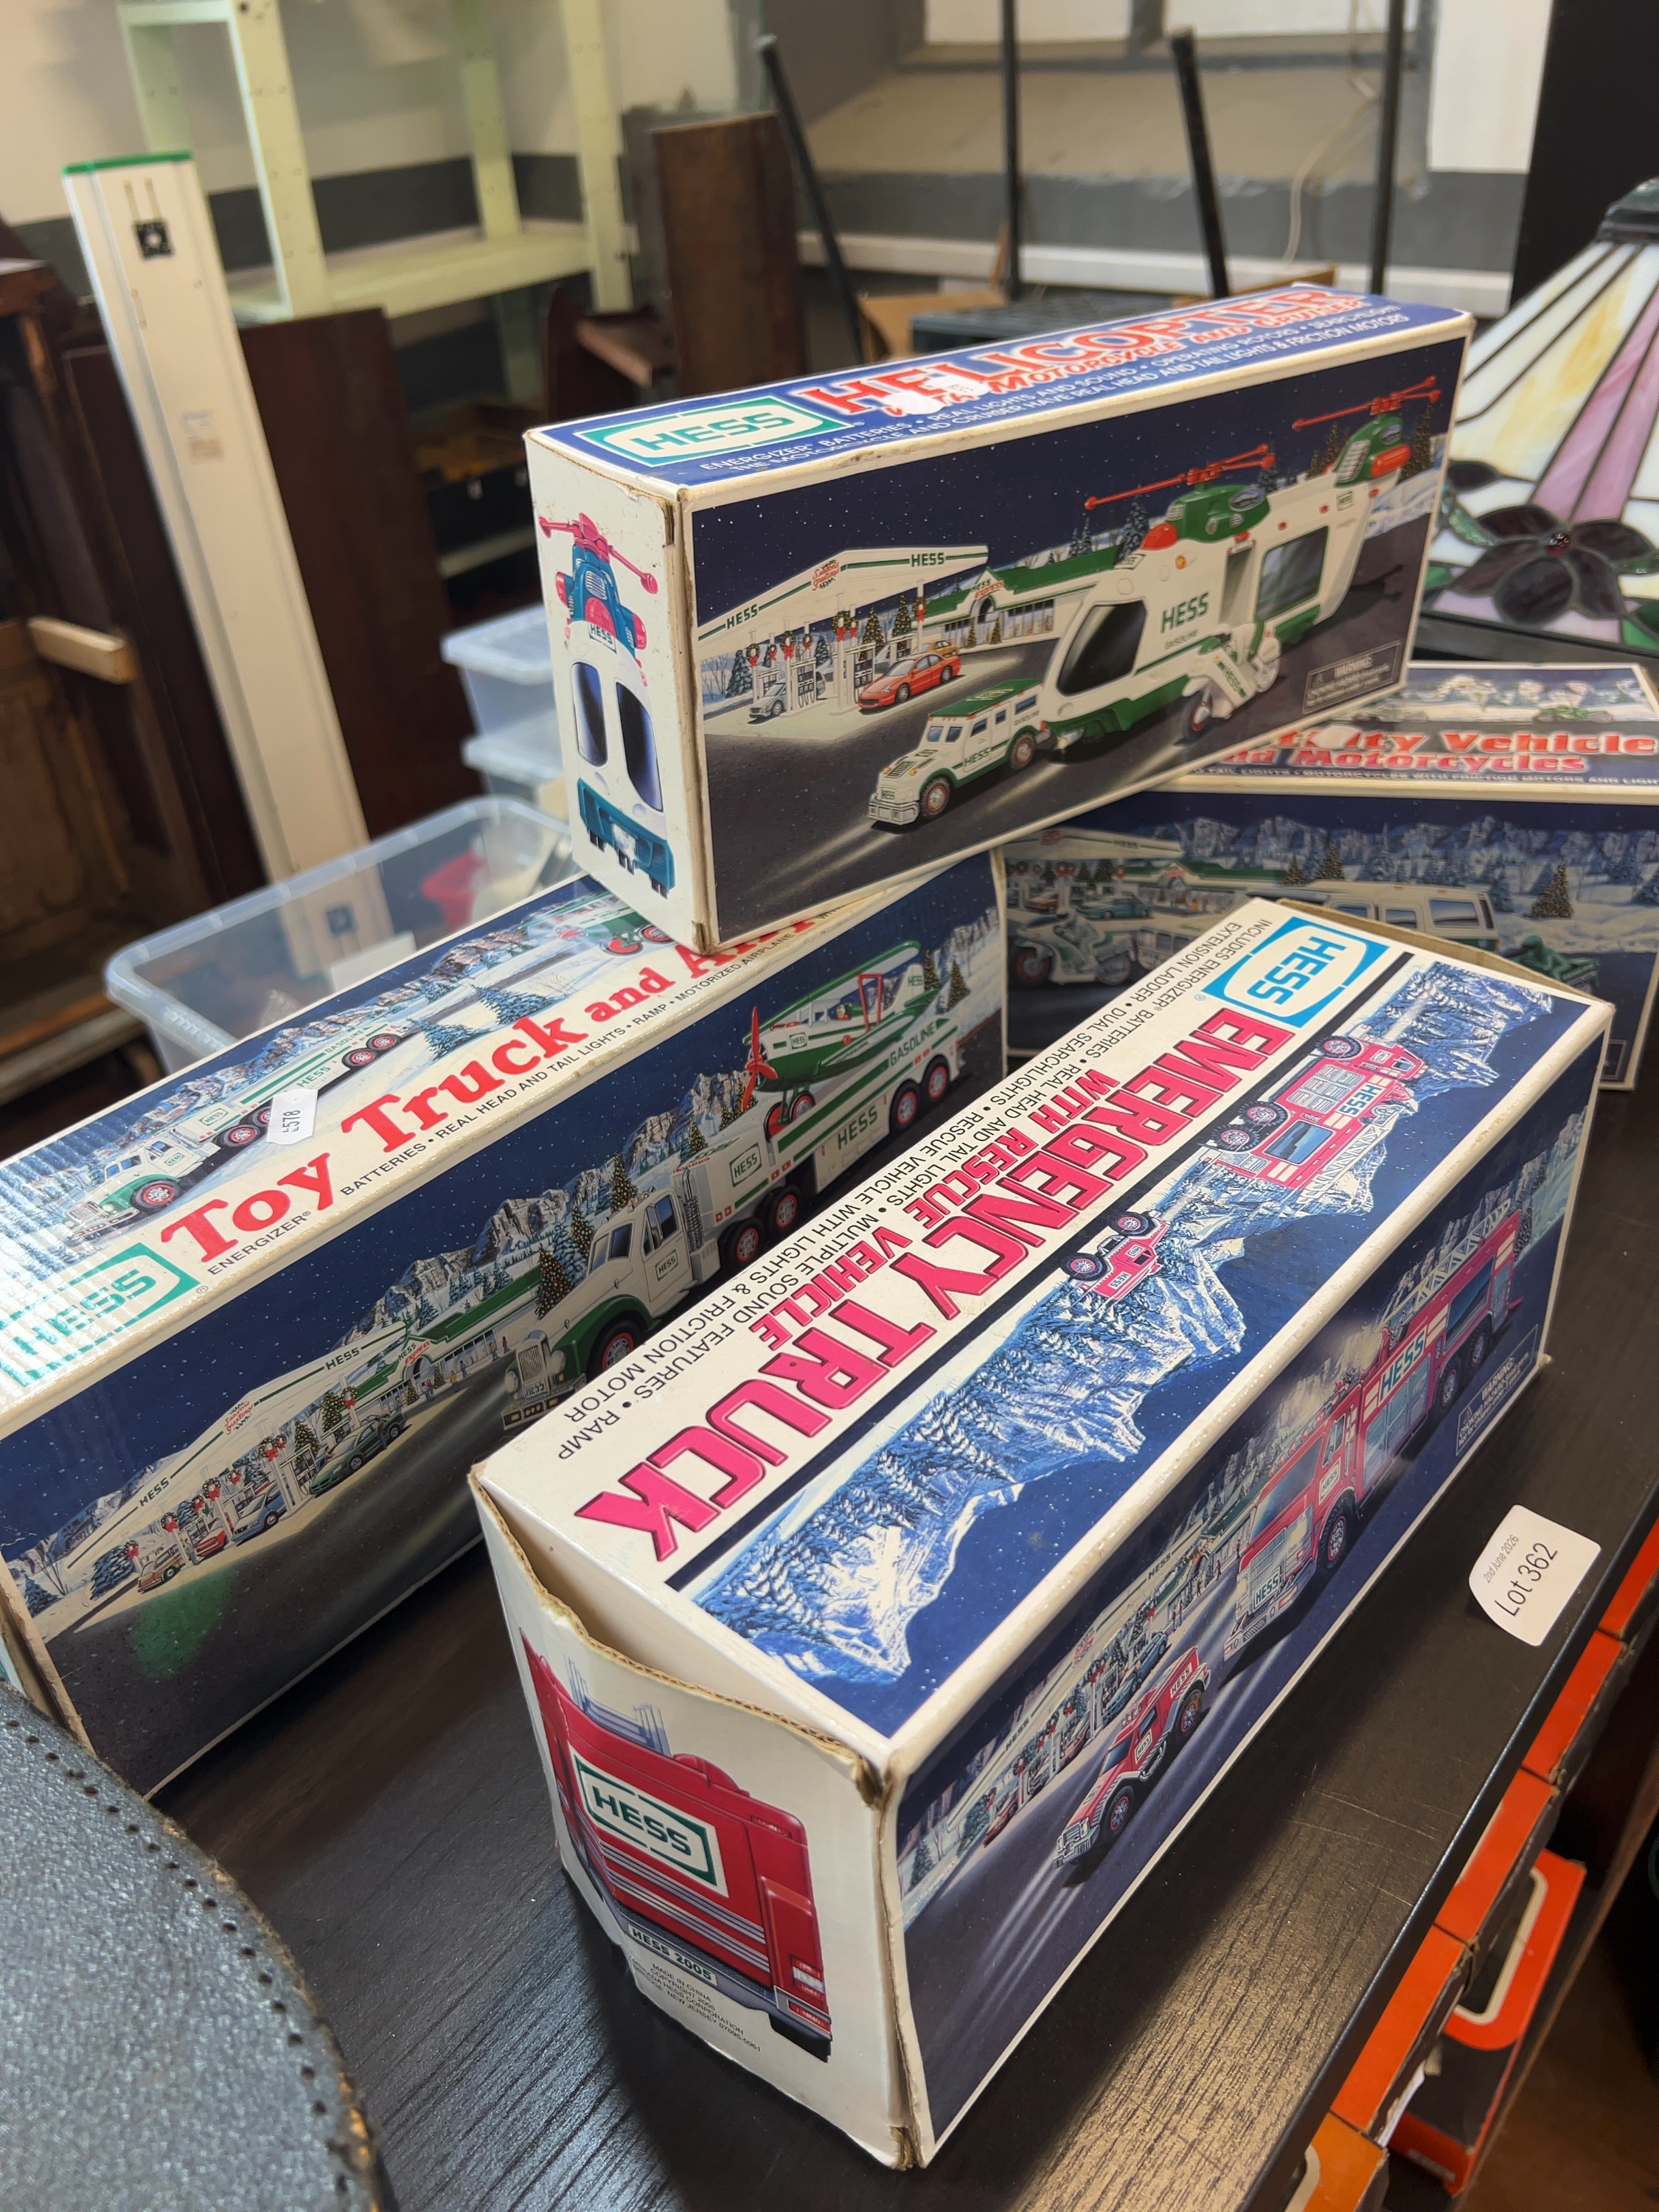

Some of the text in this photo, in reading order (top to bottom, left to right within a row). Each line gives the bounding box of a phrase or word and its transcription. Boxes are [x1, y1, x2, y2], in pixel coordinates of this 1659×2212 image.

[799, 291, 1360, 414] HELICOPTER
[911, 421, 952, 435] AND
[952, 405, 1023, 425] CRUISER
[1023, 392, 1074, 408] HAVE
[1073, 383, 1116, 398] REAL
[1116, 371, 1159, 388] HEAD
[1161, 364, 1196, 378] AND
[1195, 355, 1223, 369] TAIL
[1224, 344, 1276, 361] LIGHTS
[1285, 325, 1351, 347] FRICTION
[1349, 313, 1410, 334] MOTORS
[819, 422, 913, 446] BATTERIES
[928, 410, 970, 422] REAL
[973, 393, 1036, 414] LIGHTS
[1036, 383, 1076, 397] AND
[1074, 368, 1138, 388] SOUND
[1151, 342, 1240, 367] OPERATING
[628, 412, 795, 451] HESS
[910, 552, 945, 567] HESS
[726, 604, 758, 630] HESS
[1160, 592, 1209, 635] HESS
[590, 624, 613, 646] HESS
[964, 748, 990, 768] HESS
[1443, 731, 1657, 754] Vehicle
[1290, 748, 1587, 773] Motorcycles
[1224, 919, 1273, 960] INCLUDES
[908, 974, 925, 987] HESS
[1247, 936, 1347, 1006] HESS
[324, 1029, 364, 1055] GASOLINE
[792, 1036, 806, 1046] HESS
[890, 1022, 936, 1067] GASOLINE
[1085, 1008, 1155, 1060] BATTERIES
[296, 1065, 332, 1088] HESS
[340, 1142, 428, 1197] BATTERIES
[436, 1116, 477, 1141] REAL
[476, 1092, 518, 1117] HEAD
[518, 1072, 551, 1096] AND
[546, 1052, 577, 1076] TAIL
[576, 1026, 627, 1057] LIGHTS
[632, 1002, 668, 1026] RAMP
[674, 962, 742, 1002] MOTORIZED
[742, 933, 796, 967] AIRPLANE
[1045, 1063, 1082, 1089] REAL
[161, 964, 677, 1263] Toy Truck and
[204, 1110, 224, 1124] HESS
[1004, 1091, 1047, 1120] HEAD
[1339, 1085, 1382, 1116] HESS
[838, 1107, 879, 1151] HESS
[974, 1116, 1006, 1143] AND
[733, 1152, 758, 1179] HESS
[945, 1141, 978, 1165] TAIL
[564, 922, 1243, 1423] EXTENSION LADDER DUAL SEARCHLIGHTS RESCUE VEHICLE WITH LIGHTS & FRICTION MOTOR
[886, 1162, 947, 1207] LIGHTS
[749, 1068, 1121, 1351] WITH RESCUE VEHICLE
[798, 1213, 880, 1276] MULTIPLE
[656, 1256, 678, 1278] HESS
[1110, 1272, 1130, 1287] HESS
[574, 1008, 1295, 1562] EMERGENCY TRUCK
[733, 1273, 799, 1324] SOUND
[13, 1268, 157, 1355] HESS
[325, 1346, 361, 1371] HESS
[398, 1343, 417, 1361] HESS
[634, 1322, 737, 1400] FEATURES
[1380, 1329, 1425, 1402] HESS
[526, 1381, 545, 1397] HESS
[558, 1410, 622, 1461] RAMP
[139, 1477, 170, 1508] HESS
[1321, 1465, 1340, 1491] HESS
[1148, 1552, 1171, 1580] HESS
[1482, 1533, 1520, 1584] 2nd June 2026
[1255, 1576, 1279, 1607] HESS
[1494, 1542, 1558, 1617] Lot 362
[1172, 1663, 1191, 1694] HESS
[1004, 1714, 1030, 1753] HESS
[1137, 1734, 1152, 1758] HESS
[592, 1784, 692, 1857] HESS
[632, 1927, 671, 1958] HESS
[674, 1952, 712, 1980] 2005
[650, 1968, 696, 1999] COPYRIGHT
[651, 1963, 675, 1981] MADE
[686, 1983, 712, 2002] CHINA
[667, 1991, 686, 2005] NEW
[687, 2003, 717, 2024] JERSEY
[686, 1995, 745, 2035] CORPORATION
